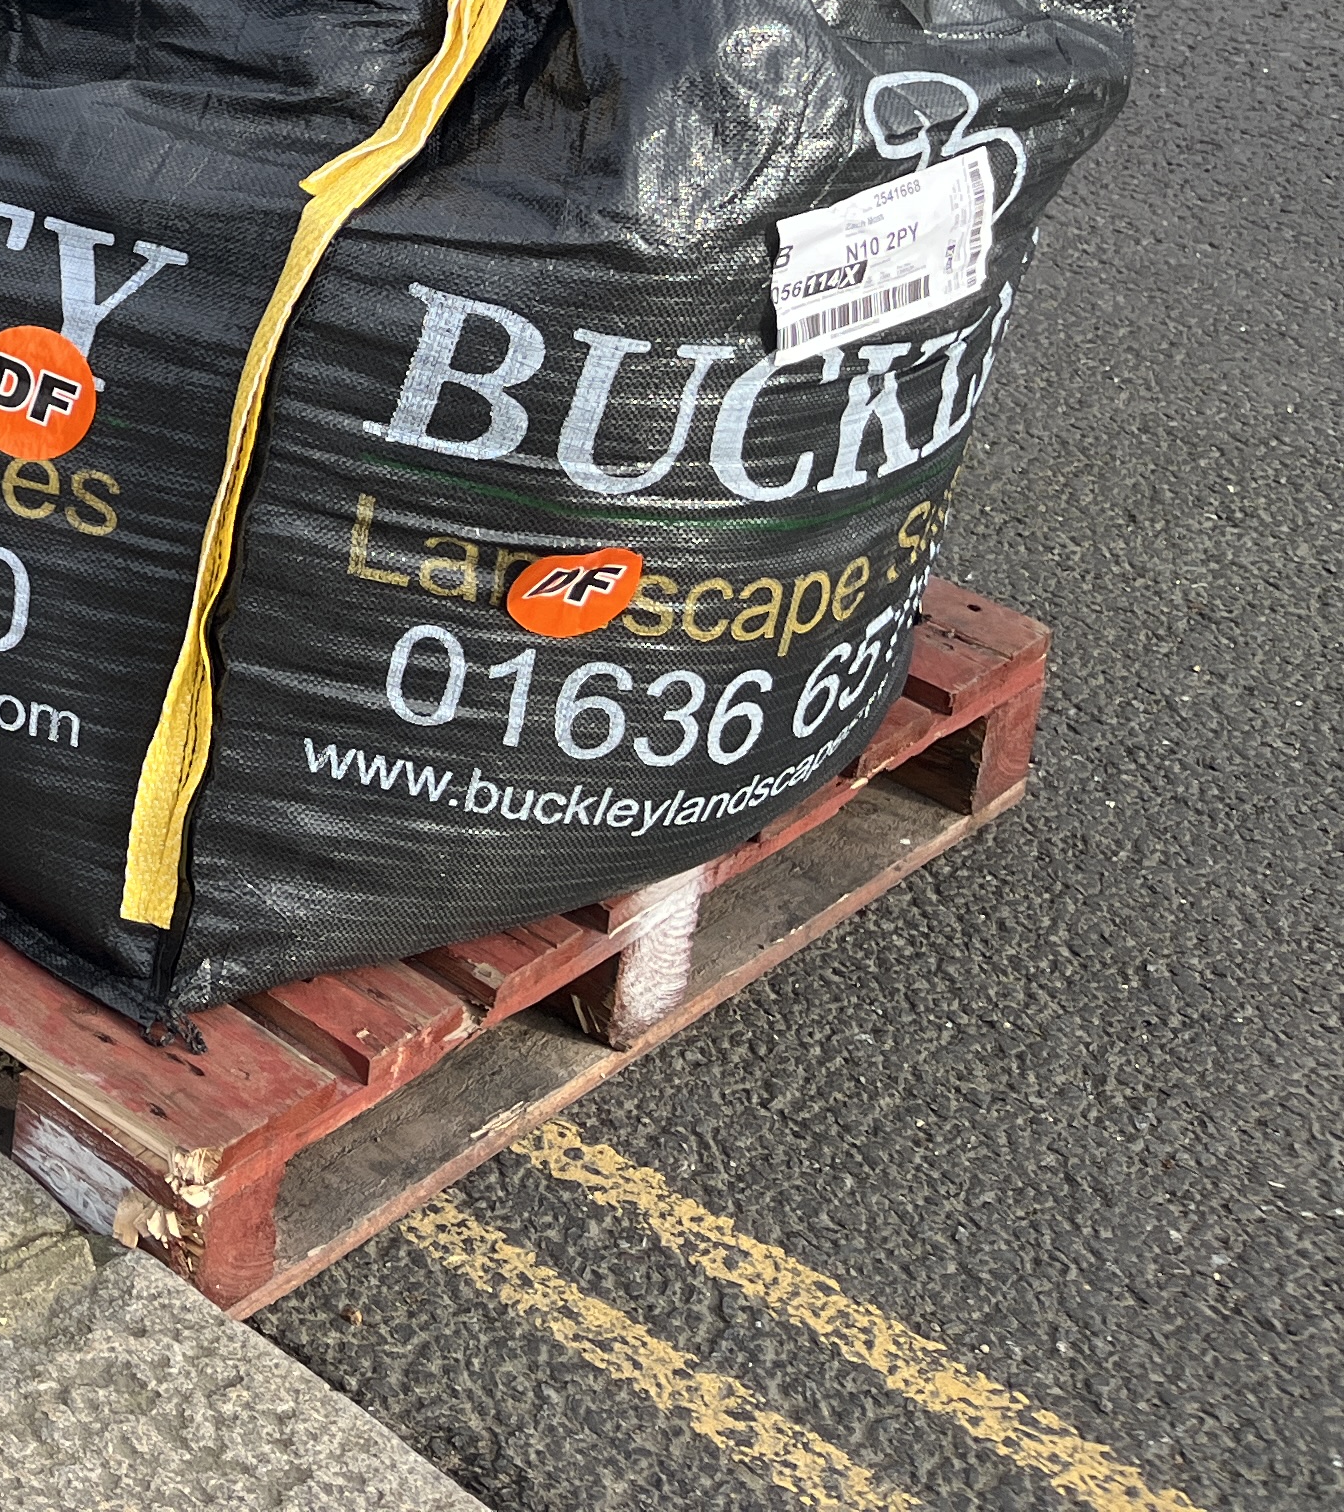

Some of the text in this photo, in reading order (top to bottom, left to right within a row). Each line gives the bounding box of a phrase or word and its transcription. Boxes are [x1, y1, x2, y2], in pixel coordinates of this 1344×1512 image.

[874, 179, 921, 208] 2541668
[845, 221, 919, 264] N10 2PY
[522, 565, 627, 606] DF
[385, 624, 773, 768] 01636
